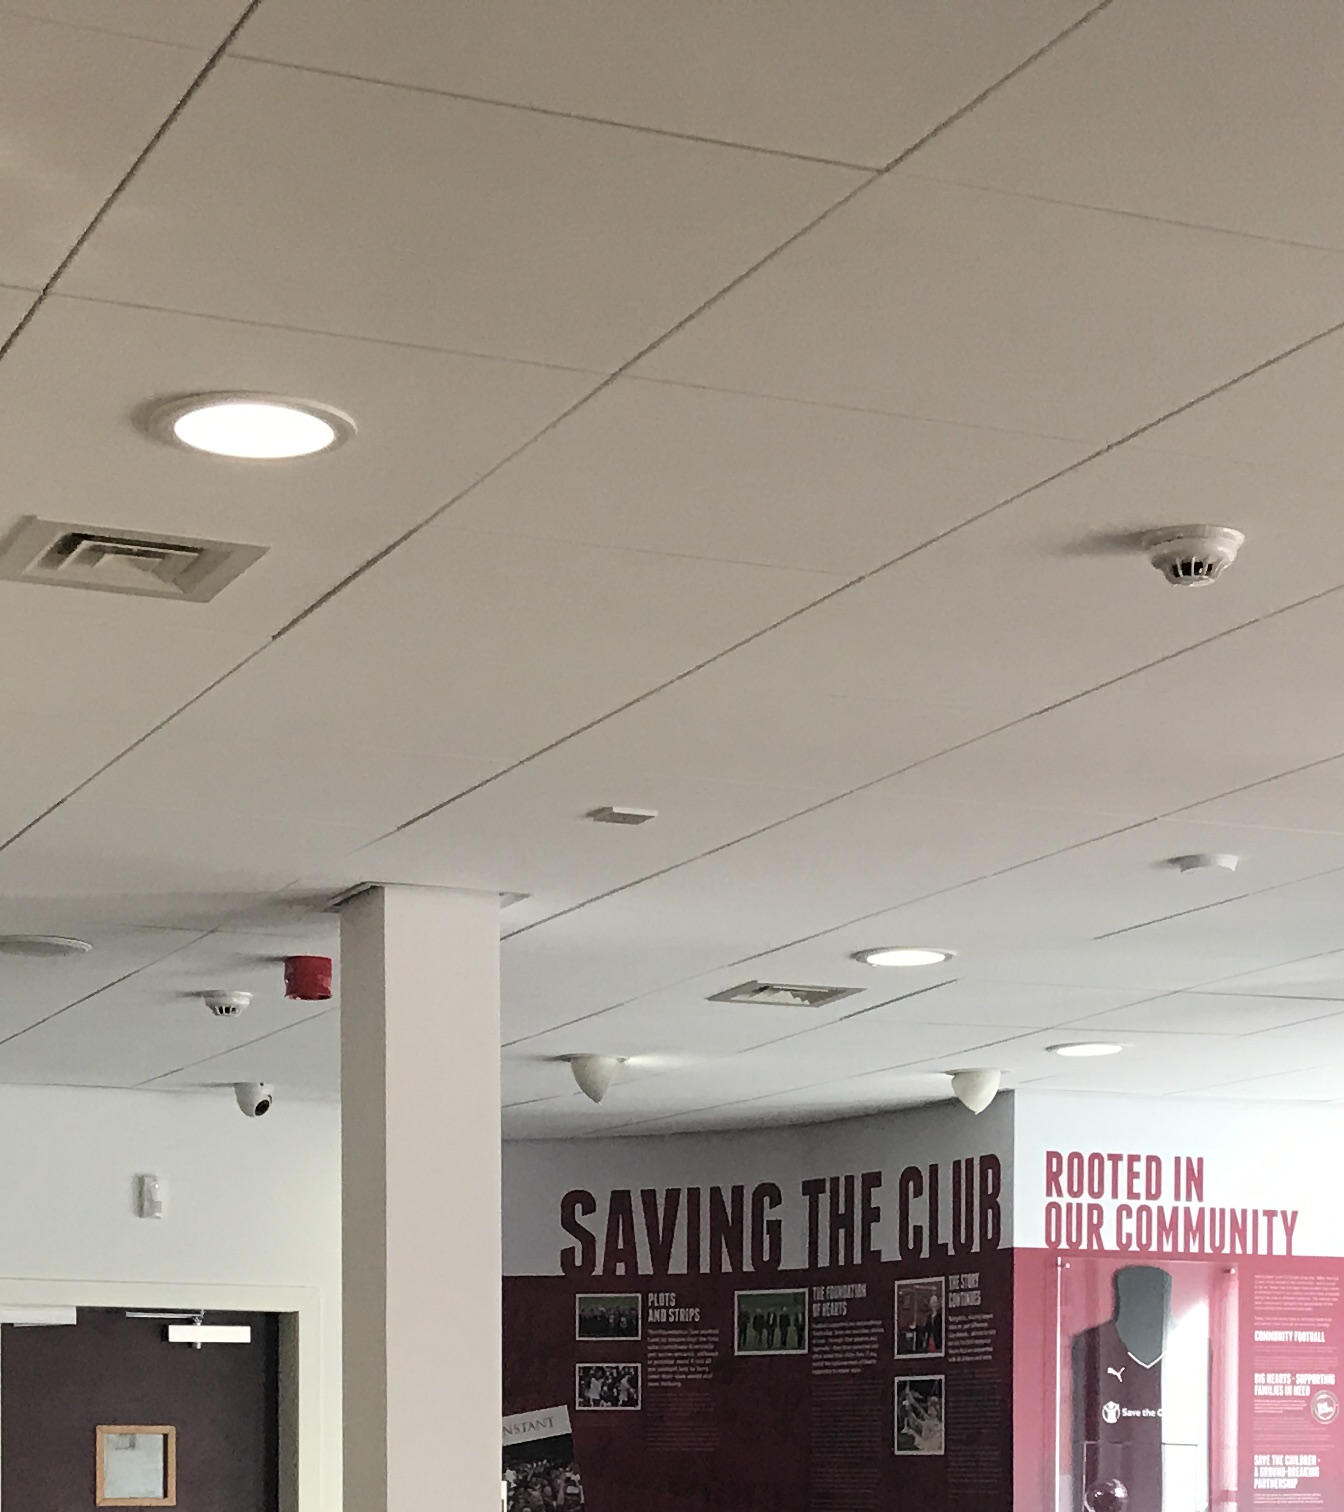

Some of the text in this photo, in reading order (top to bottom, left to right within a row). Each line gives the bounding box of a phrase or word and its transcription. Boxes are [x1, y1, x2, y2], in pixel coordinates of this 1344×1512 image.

[1045, 1150, 1204, 1202] ROOTED IN
[560, 1154, 1001, 1276] SAVING THE CLUB
[1045, 1201, 1299, 1255] OUR COMMUNITY
[648, 1292, 676, 1307] PLOTS
[648, 1308, 700, 1322] AND STRIPS
[1122, 1408, 1142, 1417] Save
[1142, 1408, 1156, 1417] the
[503, 1417, 555, 1436] NSTANT
